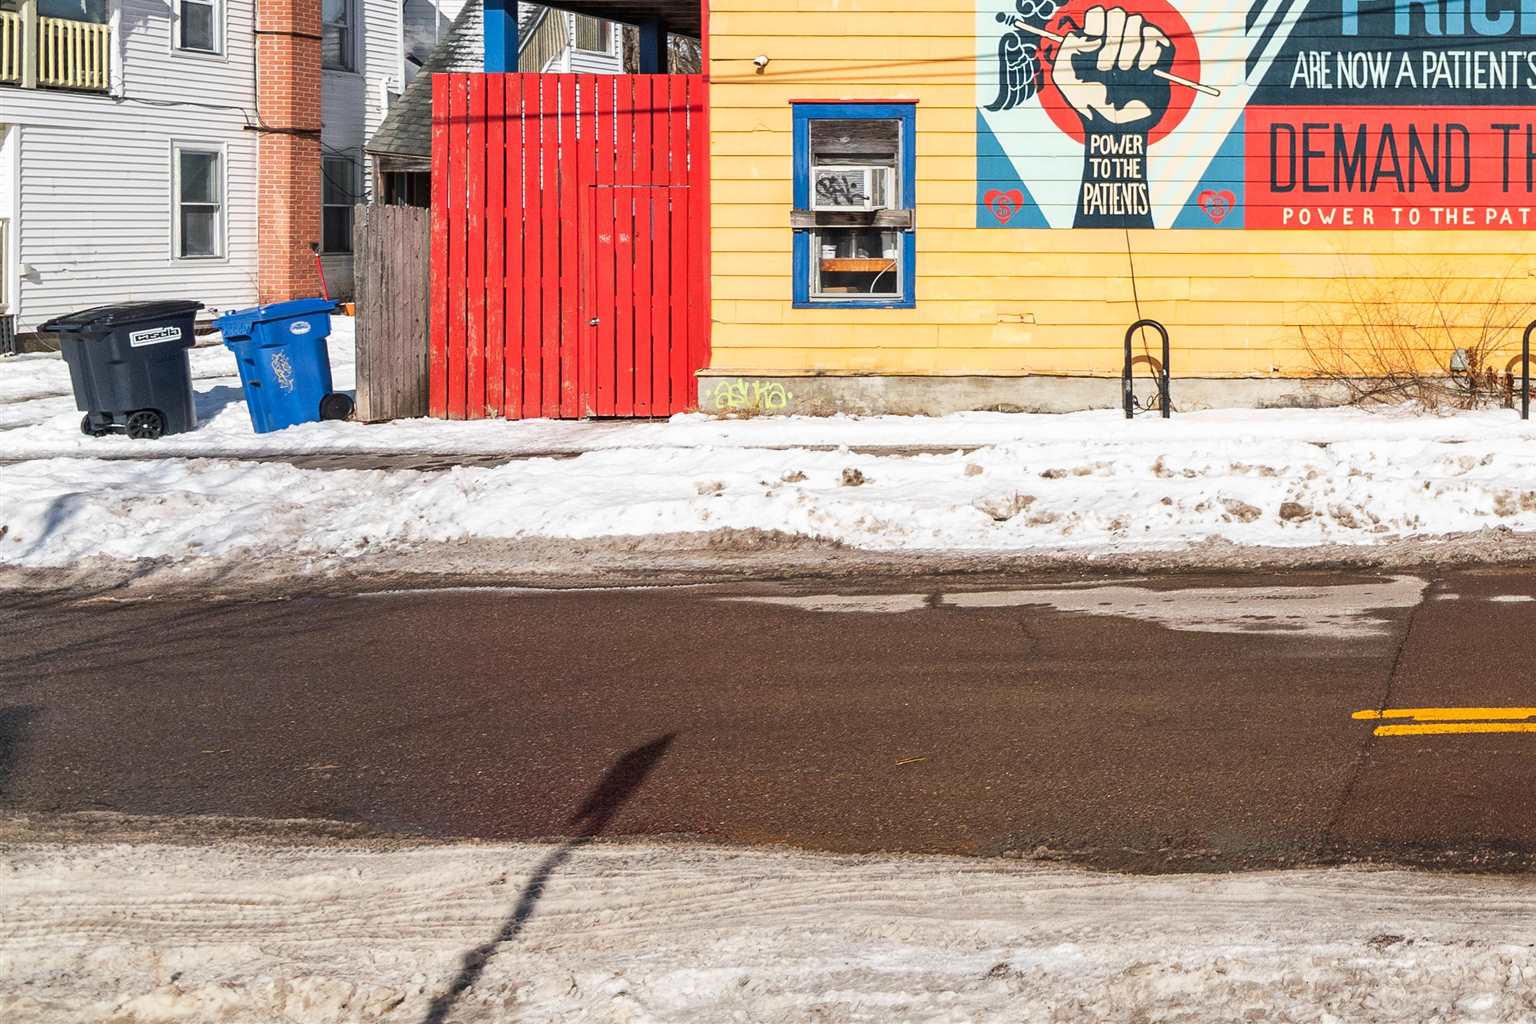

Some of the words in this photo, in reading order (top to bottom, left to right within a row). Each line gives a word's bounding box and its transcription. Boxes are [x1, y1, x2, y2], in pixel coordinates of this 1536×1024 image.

[1290, 50, 1332, 89] ARE
[1336, 50, 1392, 89] NOW
[1394, 50, 1418, 89] A
[1090, 134, 1143, 155] POWER
[1269, 123, 1471, 193] DEMAND
[1089, 158, 1111, 178] TO
[1111, 158, 1142, 179] THE
[1083, 182, 1149, 216] PATIENTS
[1282, 207, 1375, 225] POWER
[1391, 207, 1421, 225] TO
[1429, 207, 1476, 225] THE
